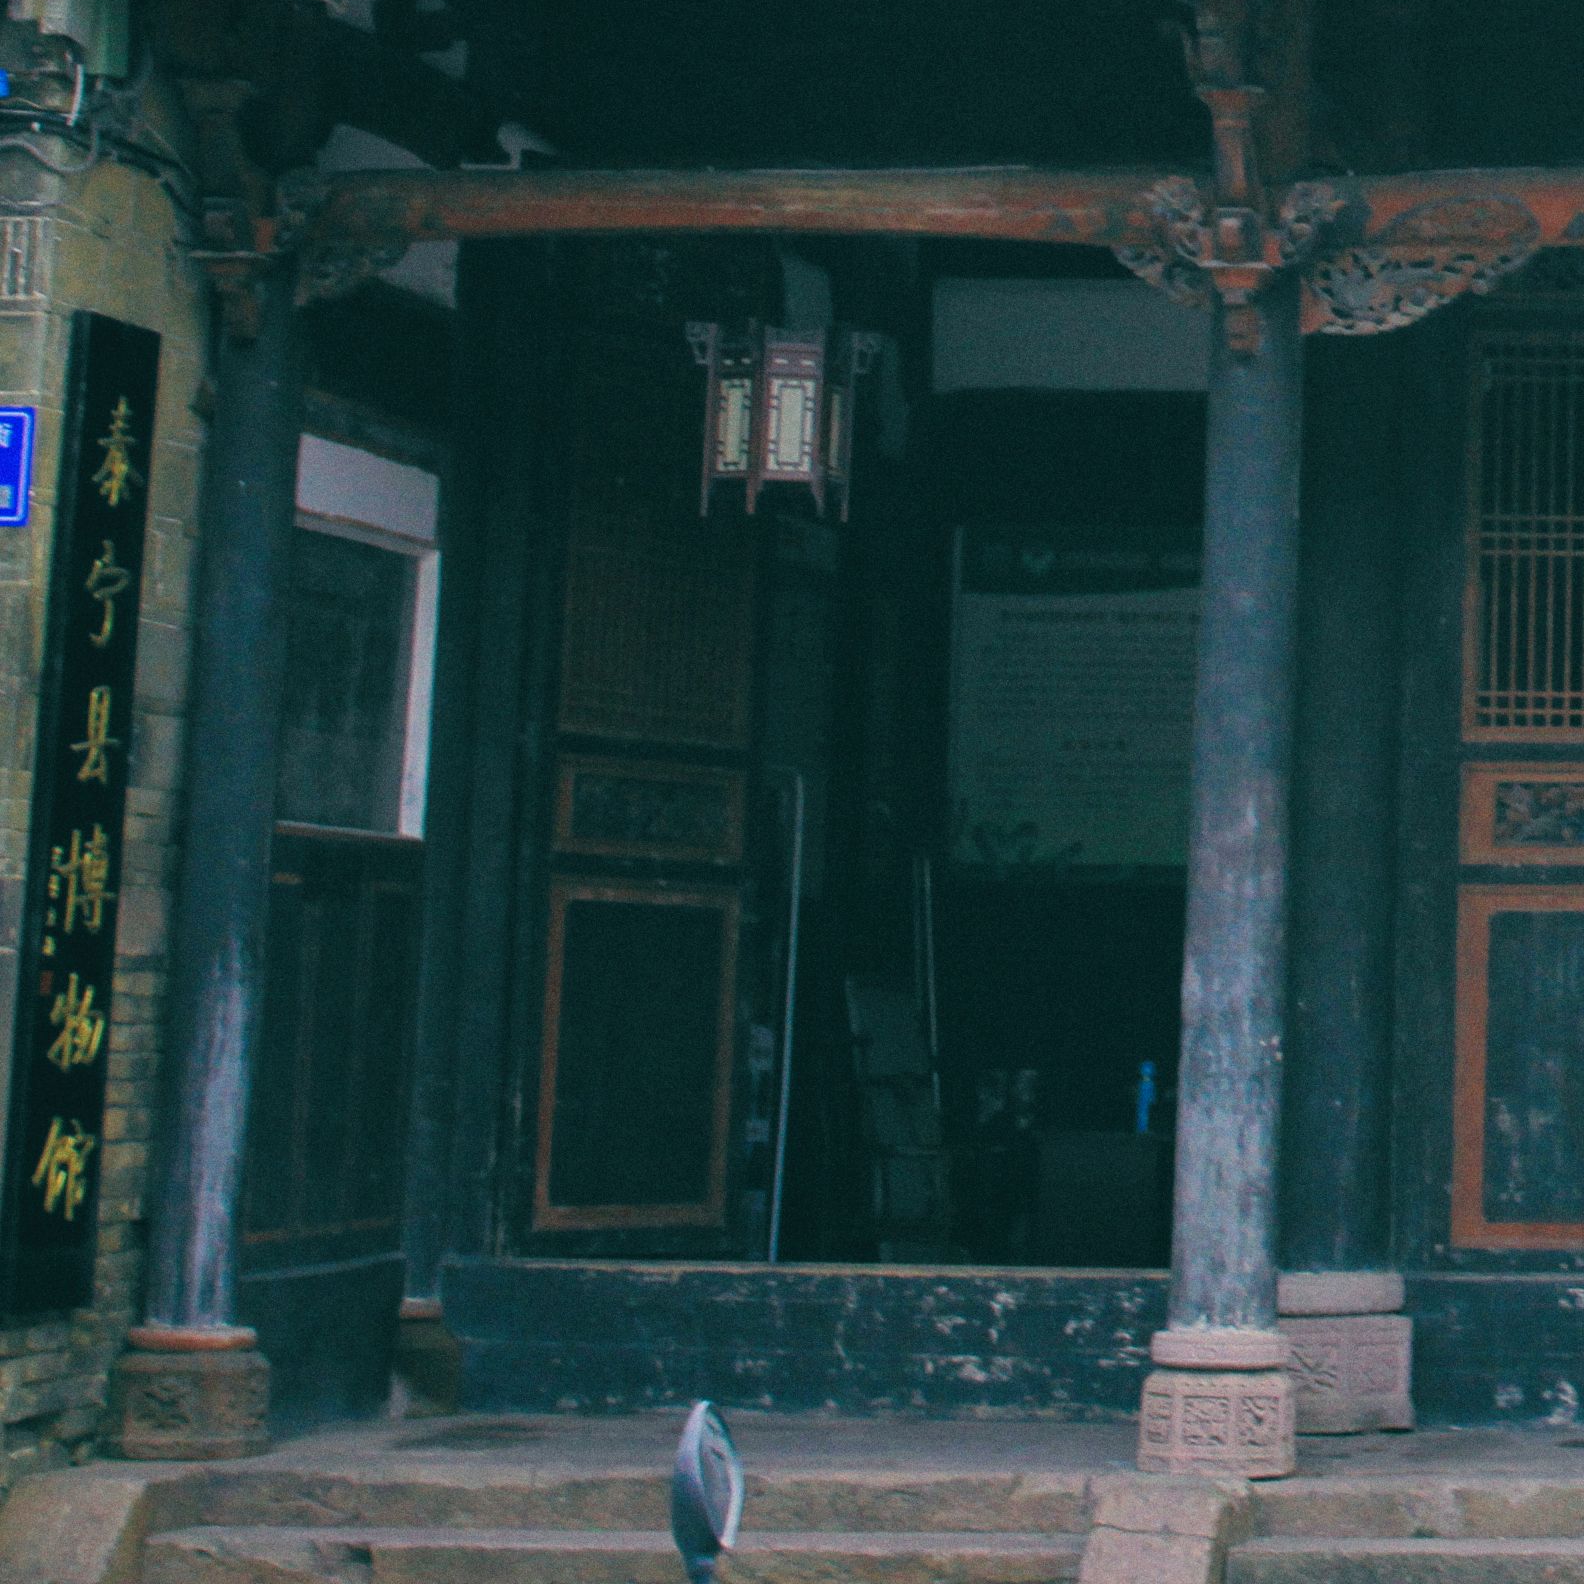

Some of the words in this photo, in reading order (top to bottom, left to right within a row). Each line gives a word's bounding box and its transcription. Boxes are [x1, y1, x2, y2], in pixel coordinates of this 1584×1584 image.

[32, 396, 144, 1222] 泰宁县博物馆
